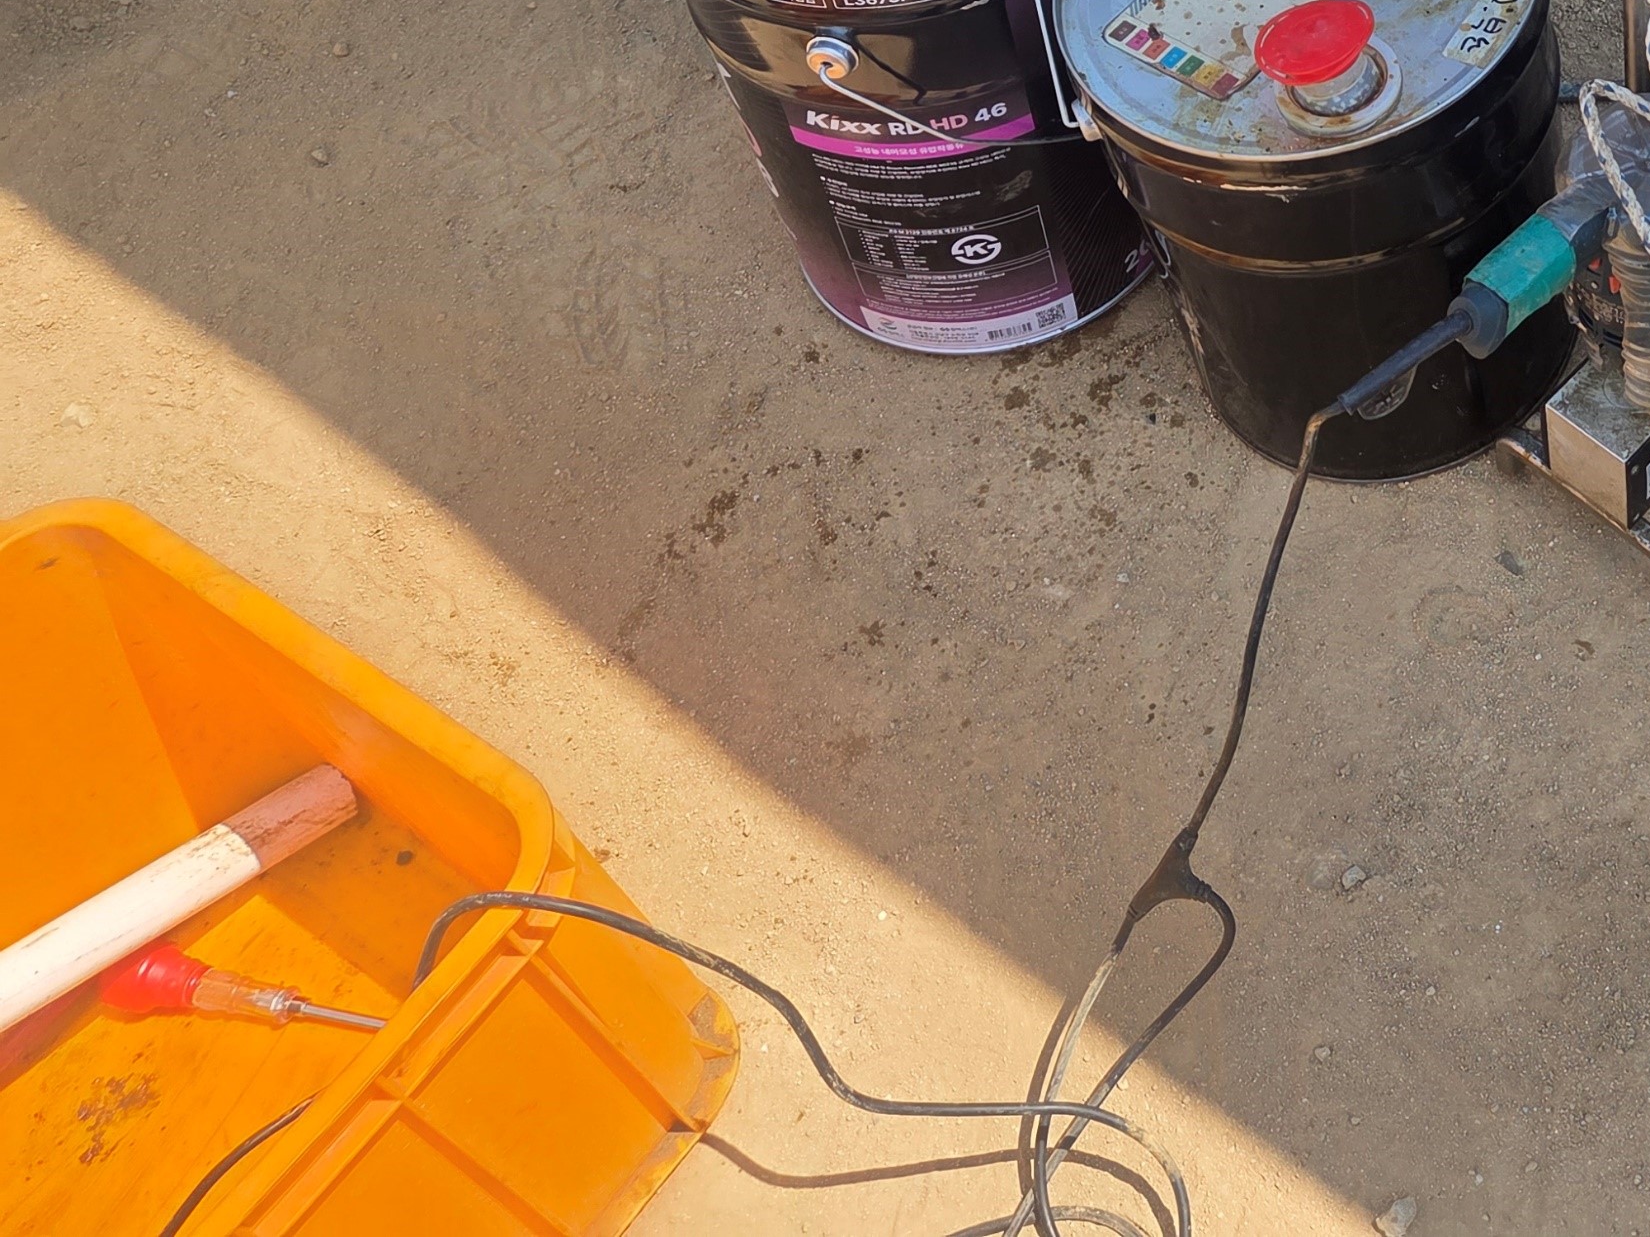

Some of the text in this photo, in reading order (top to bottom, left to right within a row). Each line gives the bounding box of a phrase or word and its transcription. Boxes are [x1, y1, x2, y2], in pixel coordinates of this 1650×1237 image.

[806, 110, 882, 136] Kixx
[930, 114, 968, 131] HD
[974, 102, 1007, 123] 46
